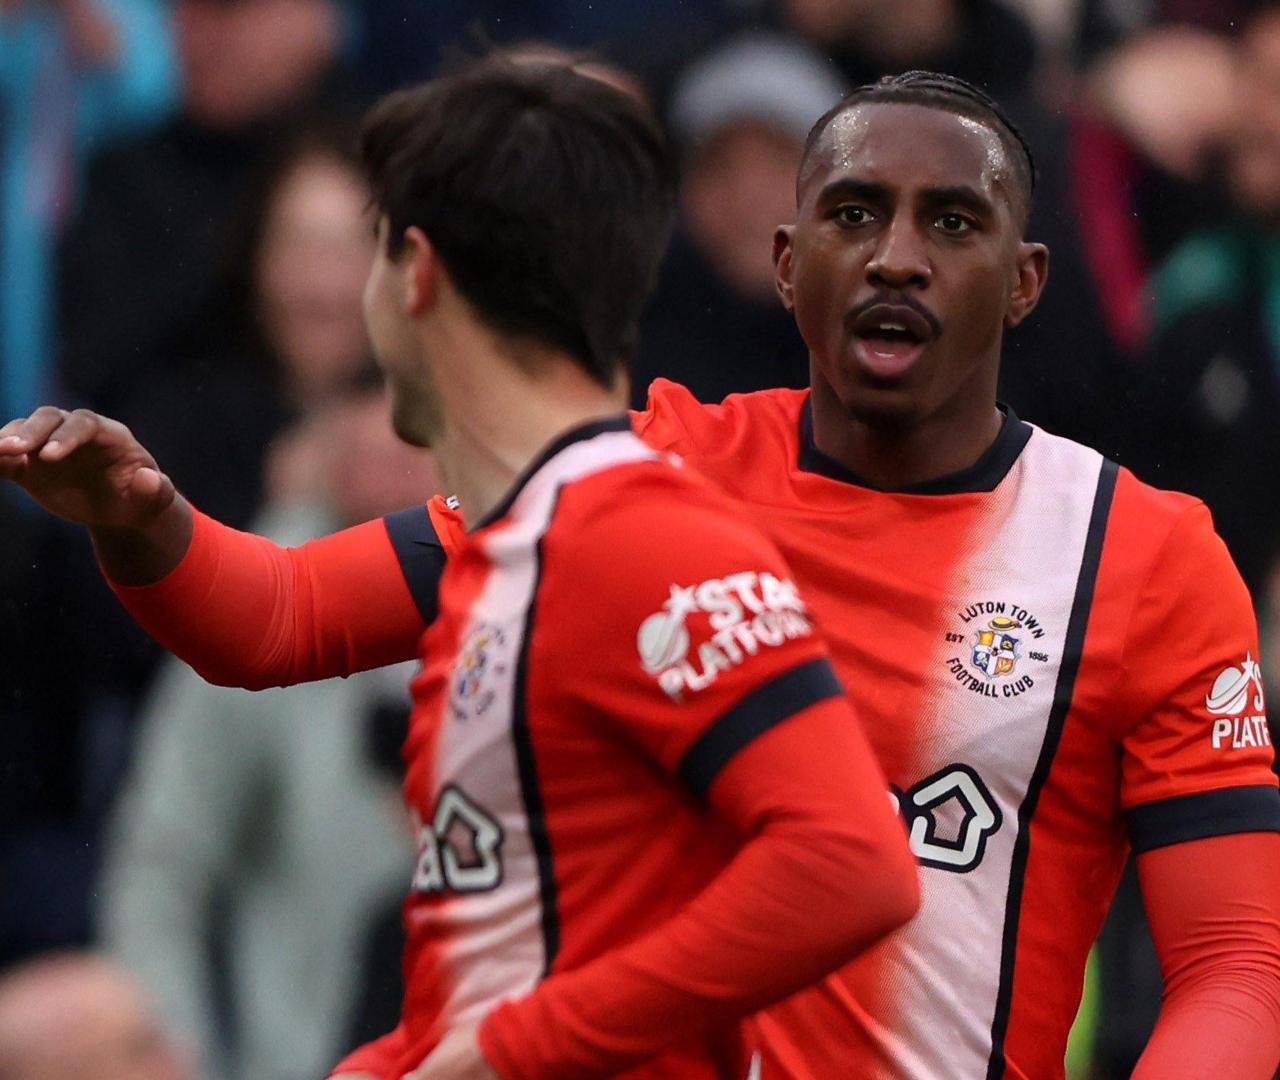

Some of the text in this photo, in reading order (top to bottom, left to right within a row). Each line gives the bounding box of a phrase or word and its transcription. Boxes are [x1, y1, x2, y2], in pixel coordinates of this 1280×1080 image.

[958, 601, 1045, 639] LUTON TOWN
[946, 657, 1034, 698] FOOTBALL CLUB
[1212, 715, 1272, 749] PLATF
